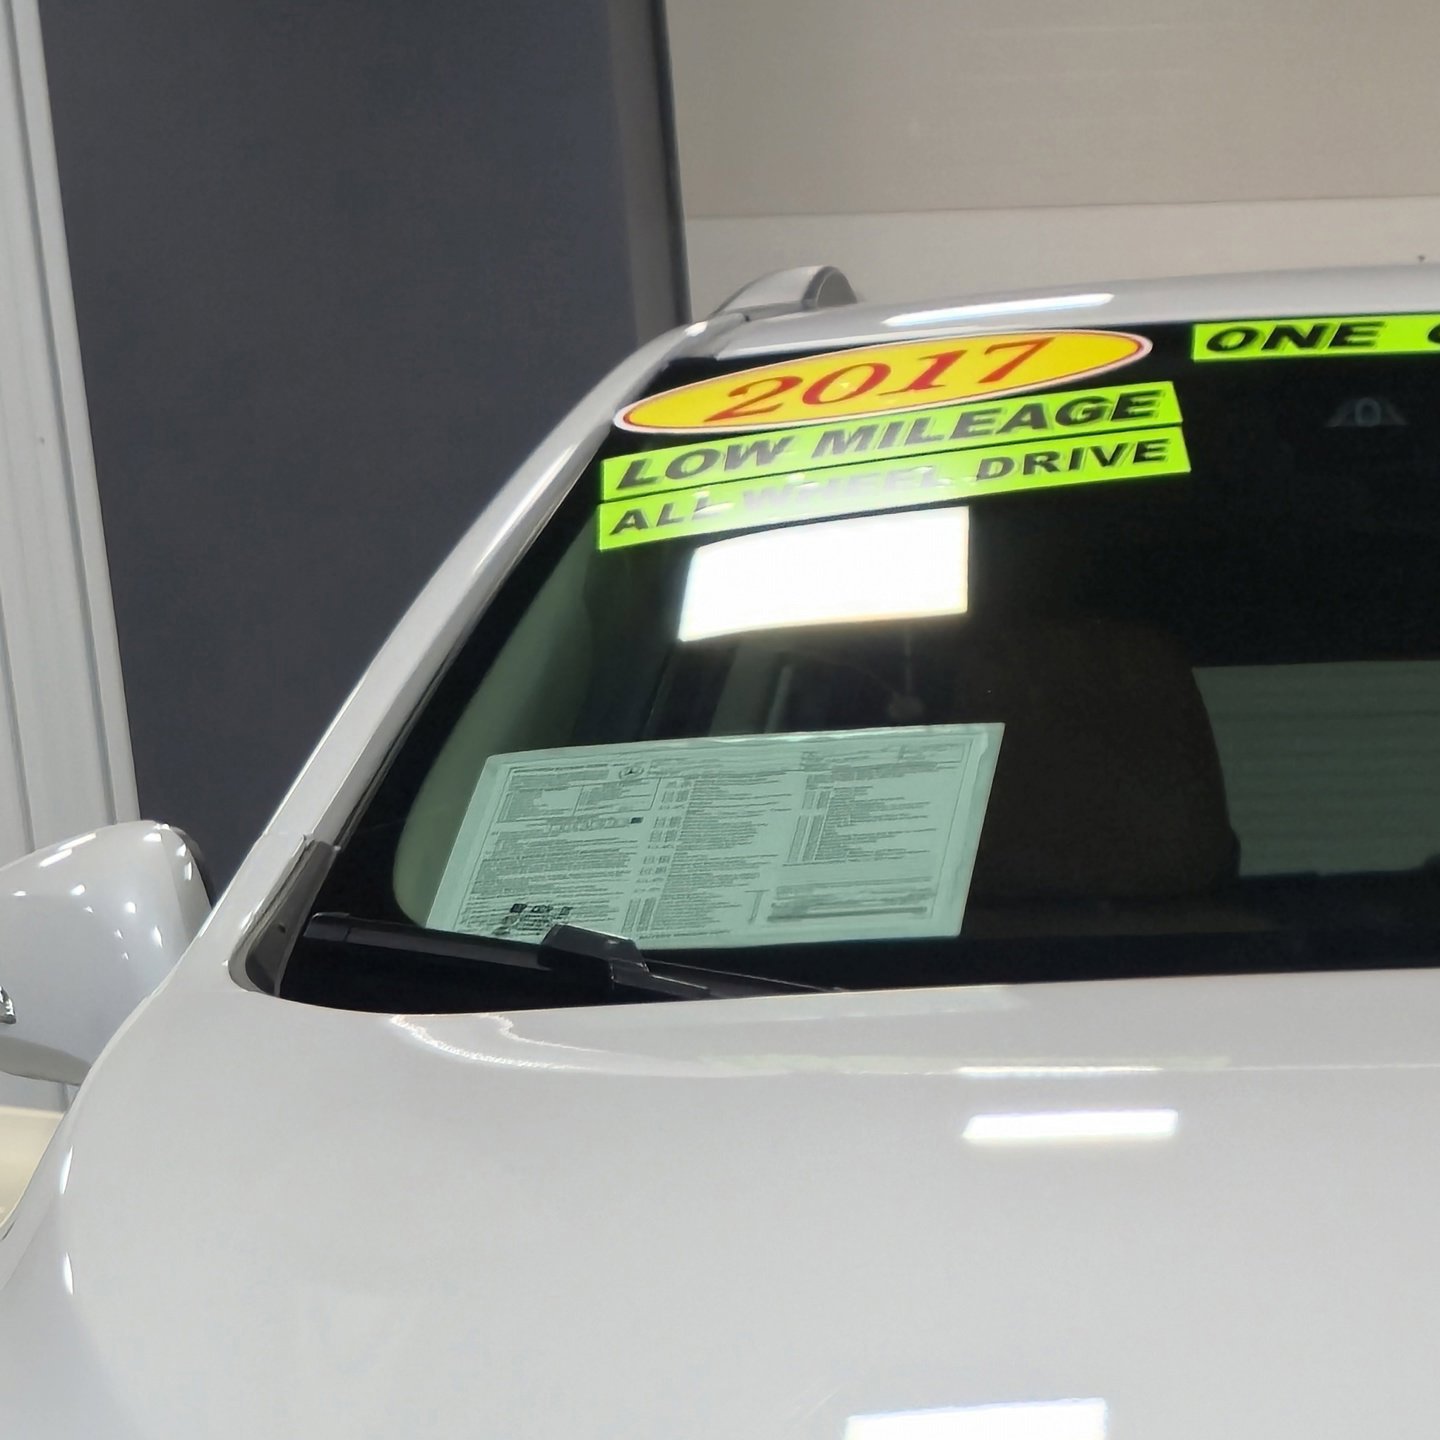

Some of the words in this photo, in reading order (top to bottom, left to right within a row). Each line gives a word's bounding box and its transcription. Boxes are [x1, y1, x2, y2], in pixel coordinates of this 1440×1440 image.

[703, 336, 1056, 423] 2017
[1205, 320, 1384, 352] ONE
[615, 435, 795, 490] LOW
[810, 388, 1164, 459] MILEAGE
[609, 490, 733, 536] ALL
[975, 437, 1170, 482] DRIVE
